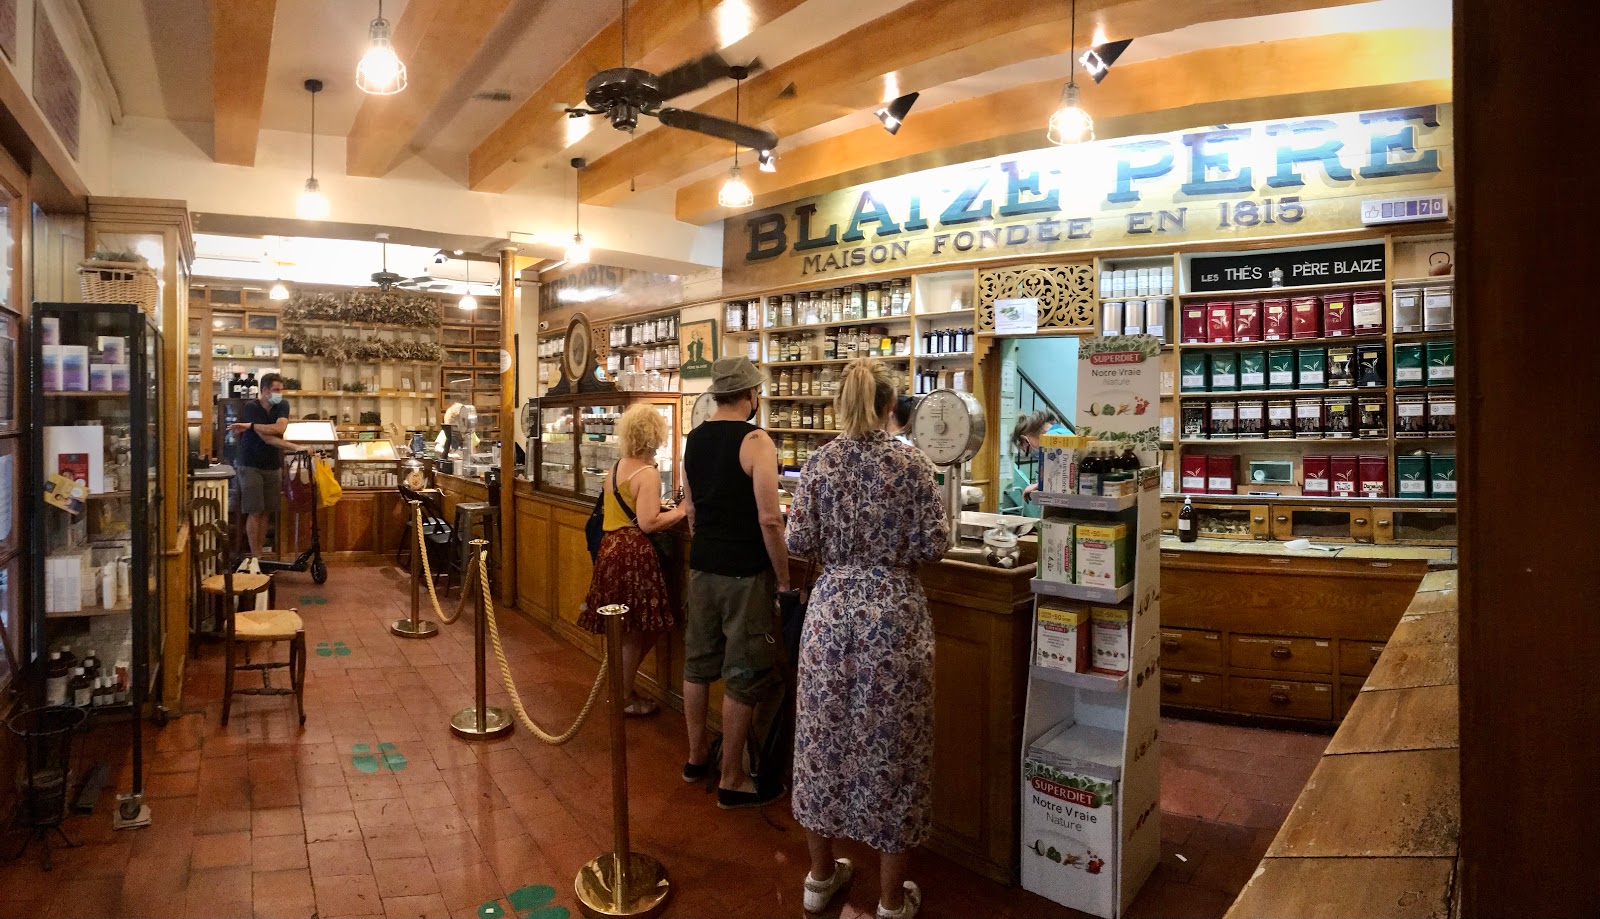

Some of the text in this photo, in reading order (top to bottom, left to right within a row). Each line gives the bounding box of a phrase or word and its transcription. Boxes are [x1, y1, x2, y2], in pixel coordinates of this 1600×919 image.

[746, 104, 1442, 262] BLAIZE PÈRE
[802, 196, 1307, 275] MAISON FONDÉE EN 1815
[1201, 258, 1382, 283] LES THÉS PÈRE BLAIZE
[1092, 353, 1140, 363] SUPERDIET
[1091, 367, 1141, 377] Notre Vraie
[1103, 378, 1131, 386] Nature
[1034, 779, 1093, 806] SUPERDIET
[1032, 794, 1098, 824] Notre Vraie
[1046, 811, 1083, 832] Nature
